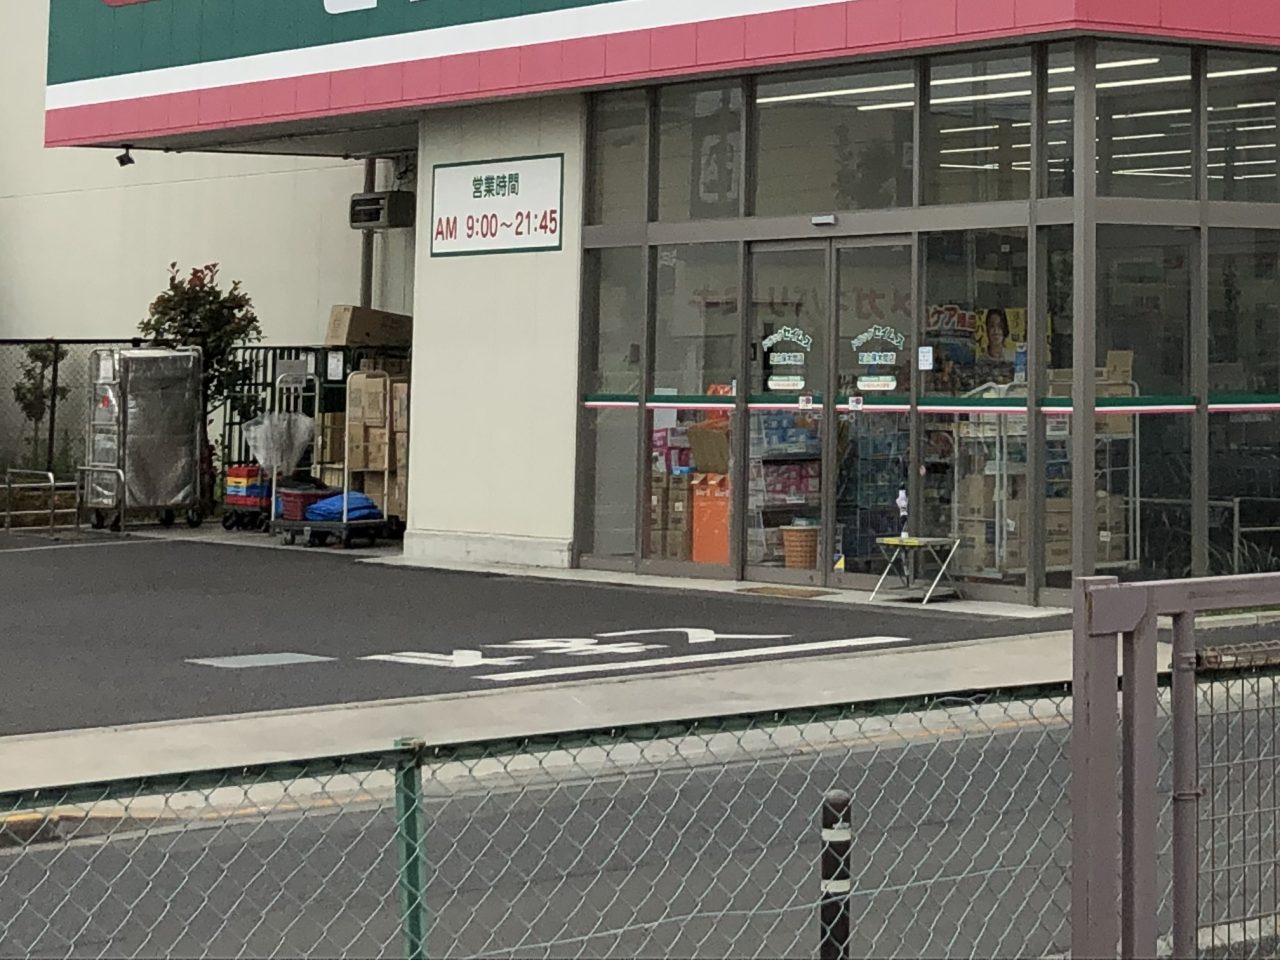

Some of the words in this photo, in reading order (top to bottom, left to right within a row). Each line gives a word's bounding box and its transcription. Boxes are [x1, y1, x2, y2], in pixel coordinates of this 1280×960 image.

[472, 172, 520, 199] 営業時間
[434, 215, 458, 241] AM
